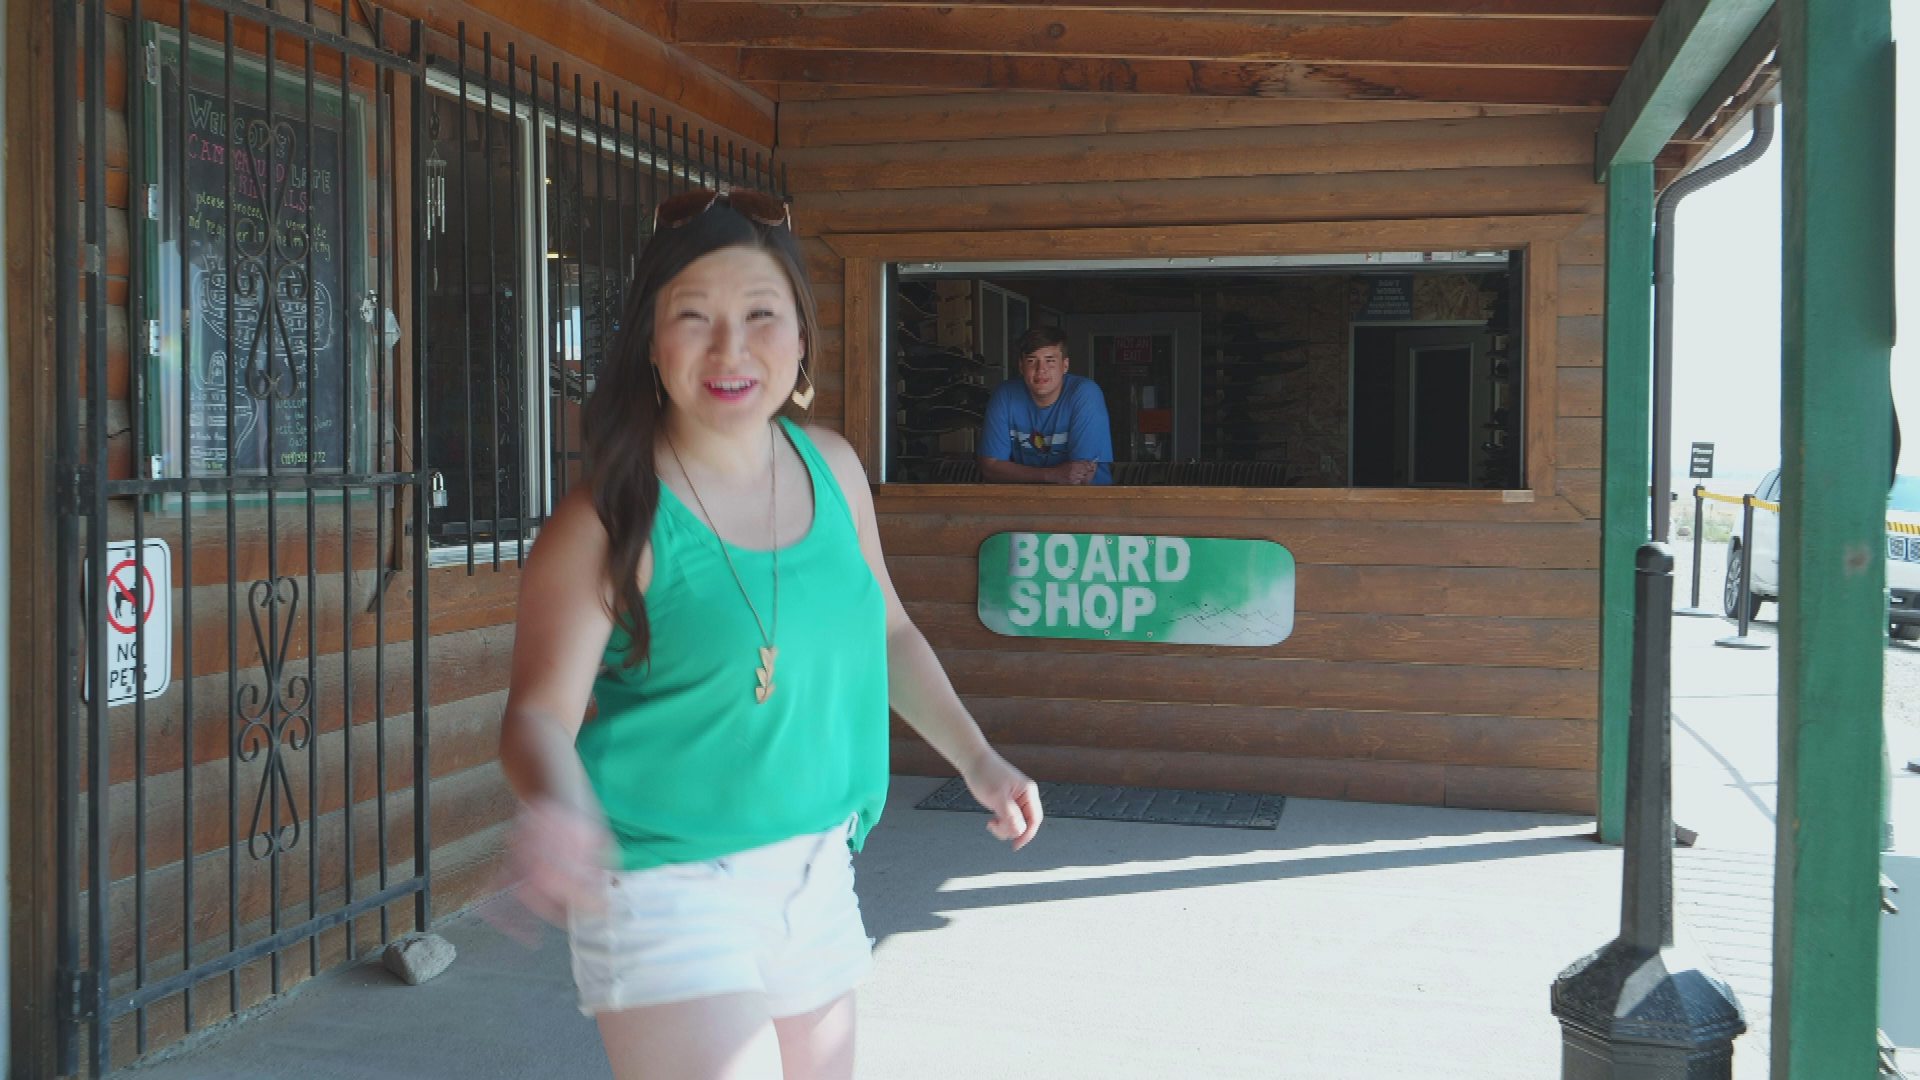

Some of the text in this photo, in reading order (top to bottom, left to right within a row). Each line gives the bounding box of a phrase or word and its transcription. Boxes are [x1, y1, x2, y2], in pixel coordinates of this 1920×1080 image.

[1117, 337, 1149, 348] NOT AN
[1123, 349, 1142, 361] EXIT
[1008, 532, 1191, 582] BOARD
[1007, 579, 1157, 632] SHOP
